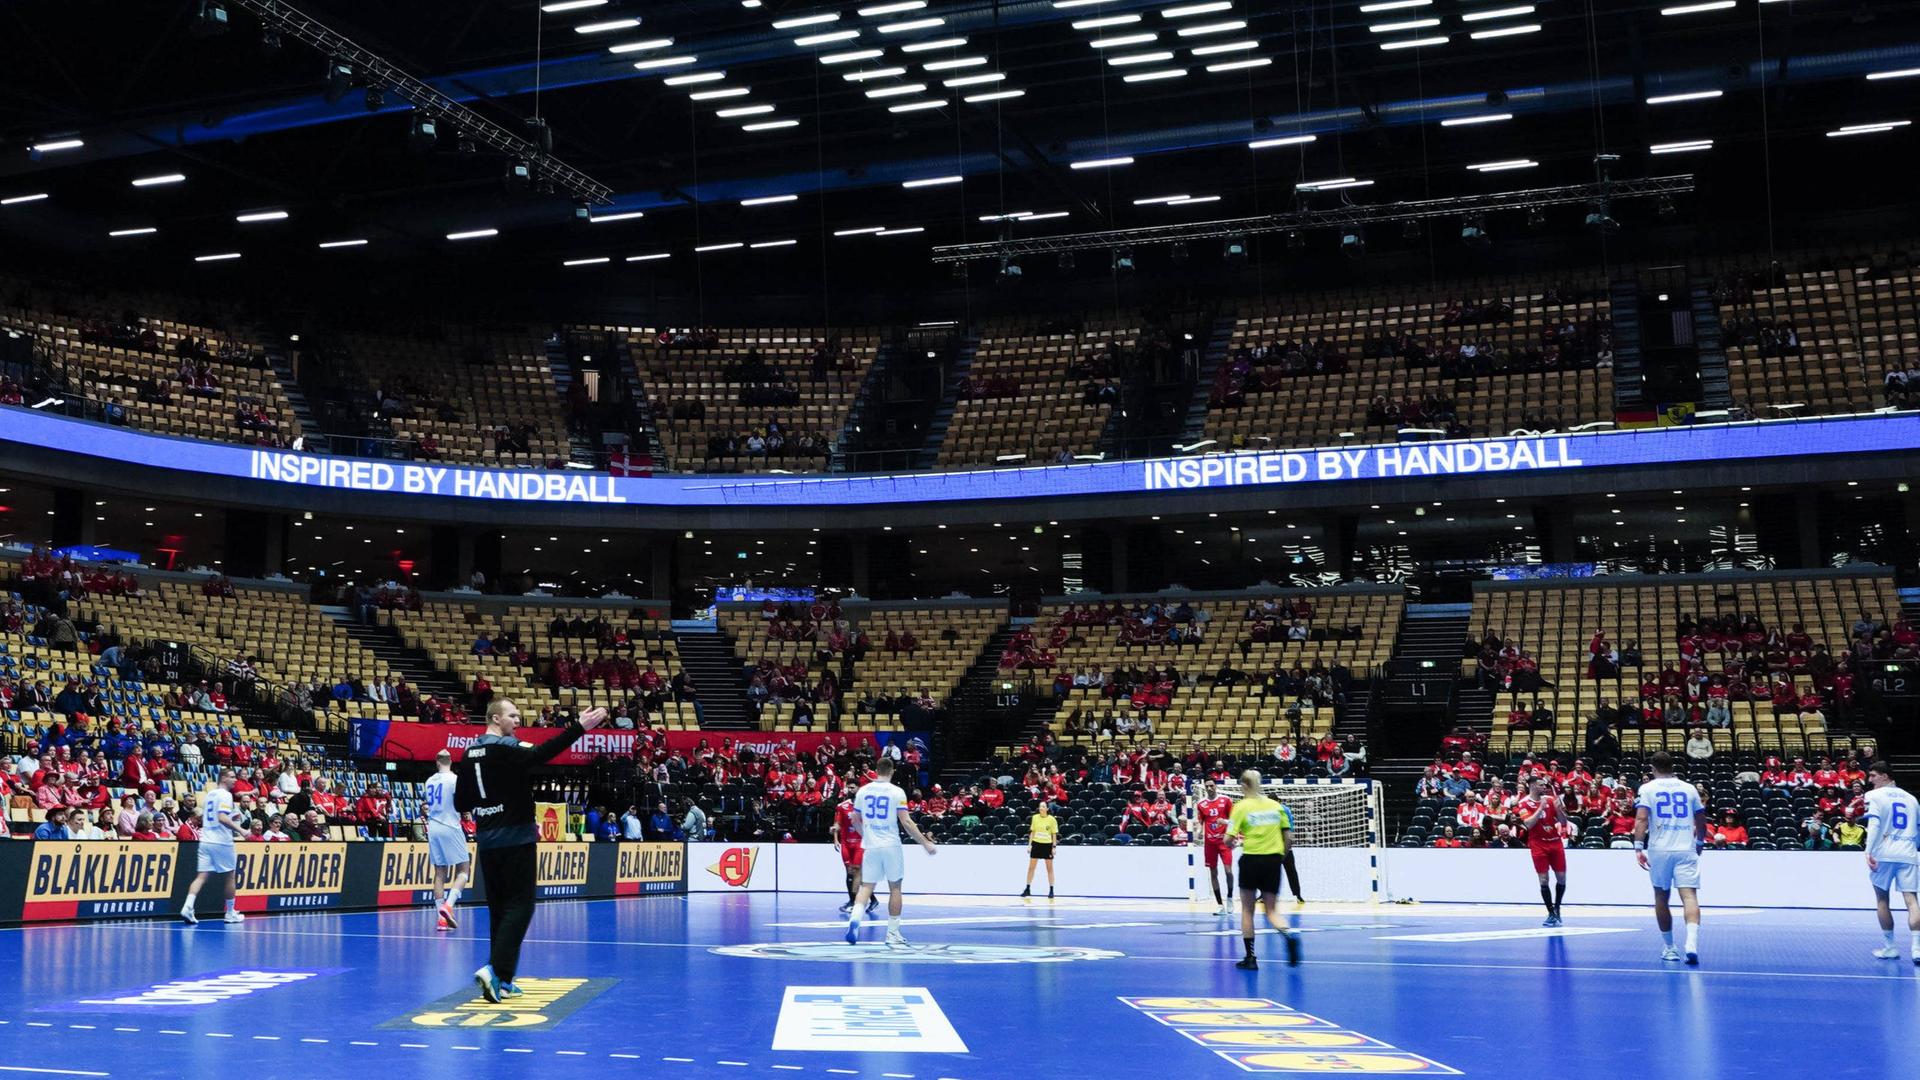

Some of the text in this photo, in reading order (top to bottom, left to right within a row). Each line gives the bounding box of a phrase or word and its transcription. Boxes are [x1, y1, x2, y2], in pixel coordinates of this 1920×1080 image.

[1145, 438, 1582, 489] INSPIRED BY HANDBALL
[251, 450, 626, 503] INSPIRED BY HANDBALL
[162, 651, 179, 666] L14
[1411, 683, 1426, 696] L1
[1883, 678, 1905, 692] L2
[997, 695, 1019, 706] L15
[571, 734, 653, 753] HERNIN
[474, 762, 487, 799] 1
[427, 783, 443, 806] 34
[1656, 791, 1689, 818] 28
[207, 800, 214, 822] 2
[864, 795, 890, 819] 39
[1892, 802, 1908, 829] 6
[33, 843, 172, 896] BLÅKLÄDER
[234, 844, 341, 890] BLÅKLÄDER
[538, 845, 586, 881] KLÄDER
[619, 845, 681, 878] BLÅKLÄDER
[93, 900, 155, 914] WORKWEAR
[279, 895, 329, 907] WORKWEAR
